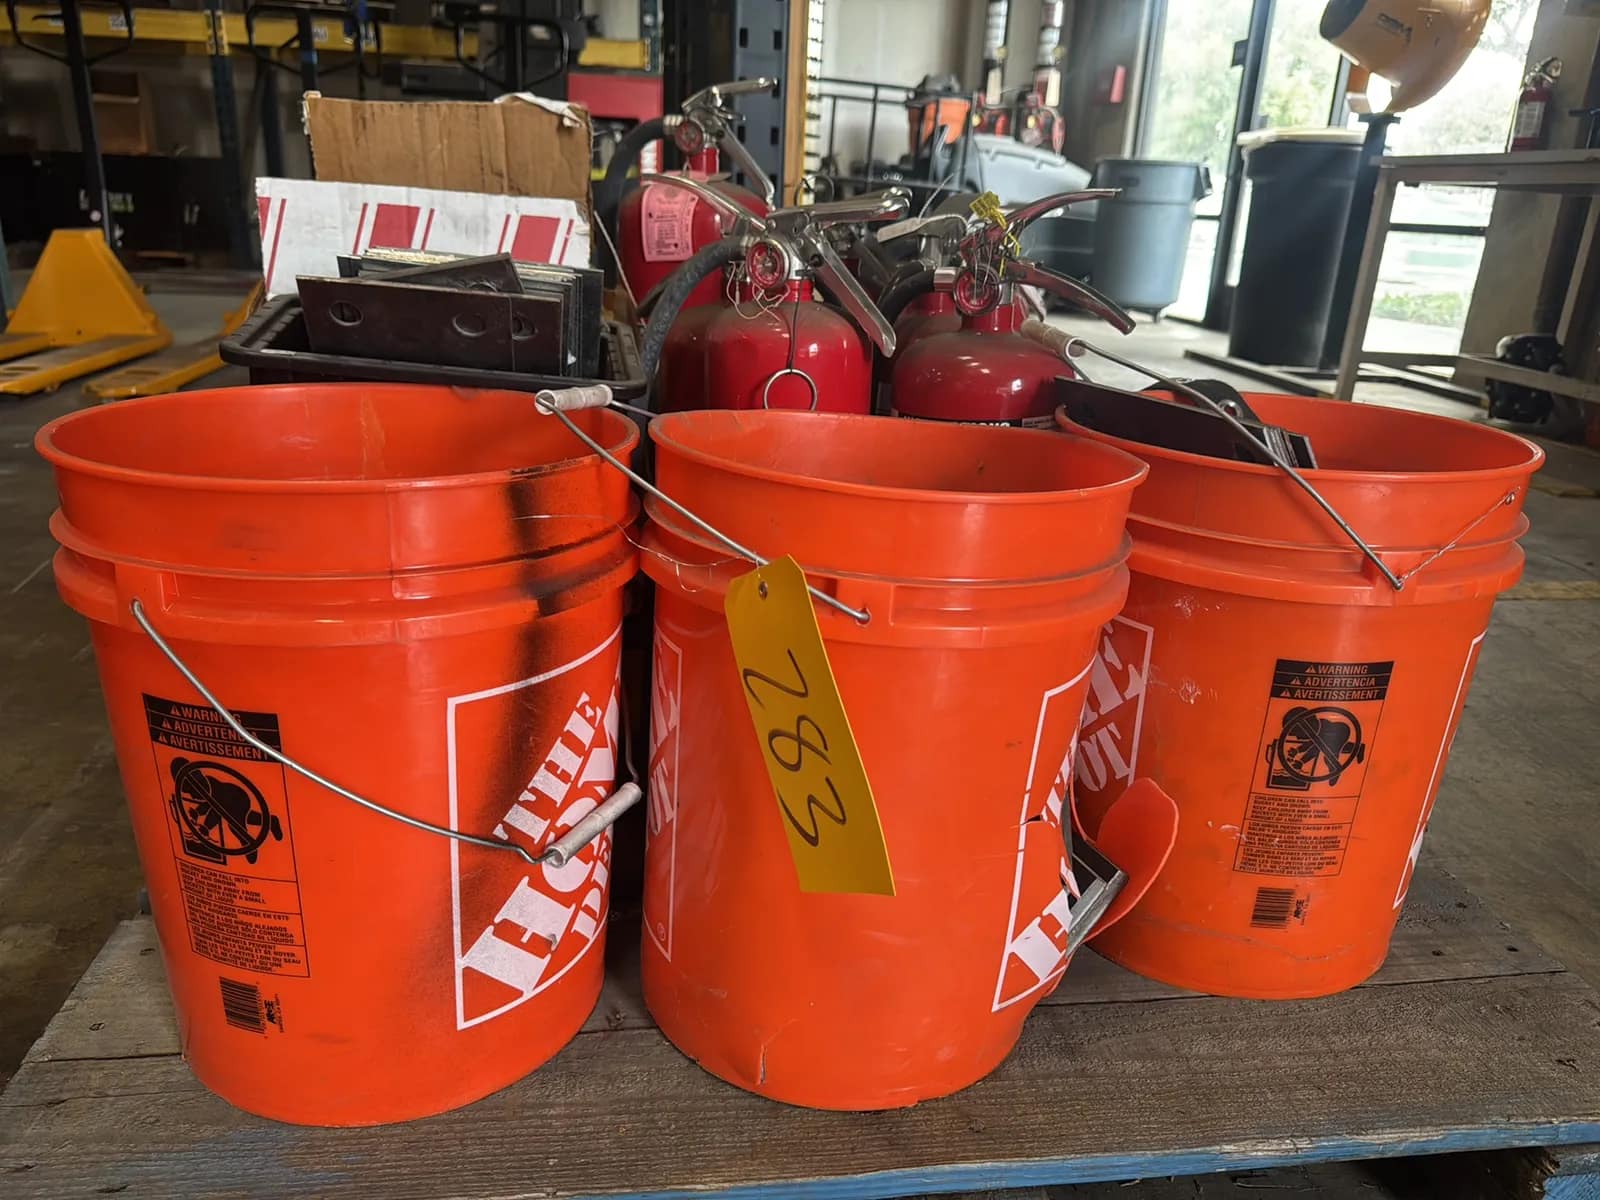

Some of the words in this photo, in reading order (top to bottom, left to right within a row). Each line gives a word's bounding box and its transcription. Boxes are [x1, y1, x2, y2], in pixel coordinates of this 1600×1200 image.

[1317, 664, 1368, 675] WARNING
[1304, 676, 1376, 687] ADVERTENCIA
[1294, 689, 1380, 700] AVERTISSEMENT
[181, 706, 242, 725] WARNIG
[174, 720, 258, 743] ADVERTENC
[170, 734, 268, 761] AVERTISSEMENT
[743, 648, 847, 847] 283
[493, 691, 602, 845] THE
[461, 684, 620, 998] HOM
